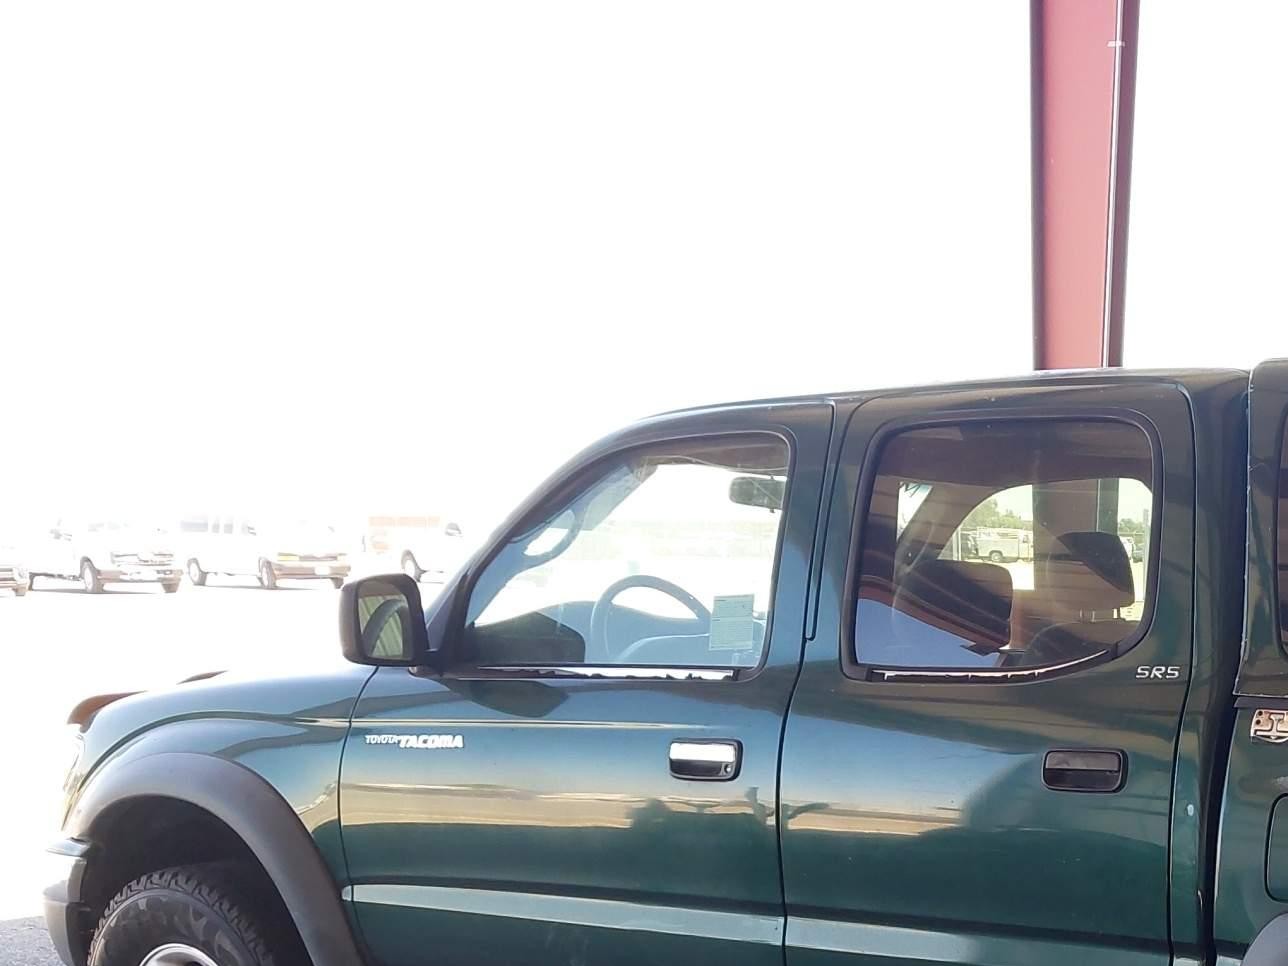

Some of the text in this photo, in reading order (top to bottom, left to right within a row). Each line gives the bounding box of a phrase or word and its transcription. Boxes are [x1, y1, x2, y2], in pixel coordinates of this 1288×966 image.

[1135, 665, 1181, 679] SR5
[364, 734, 464, 748] TOYOTA TACOMA
